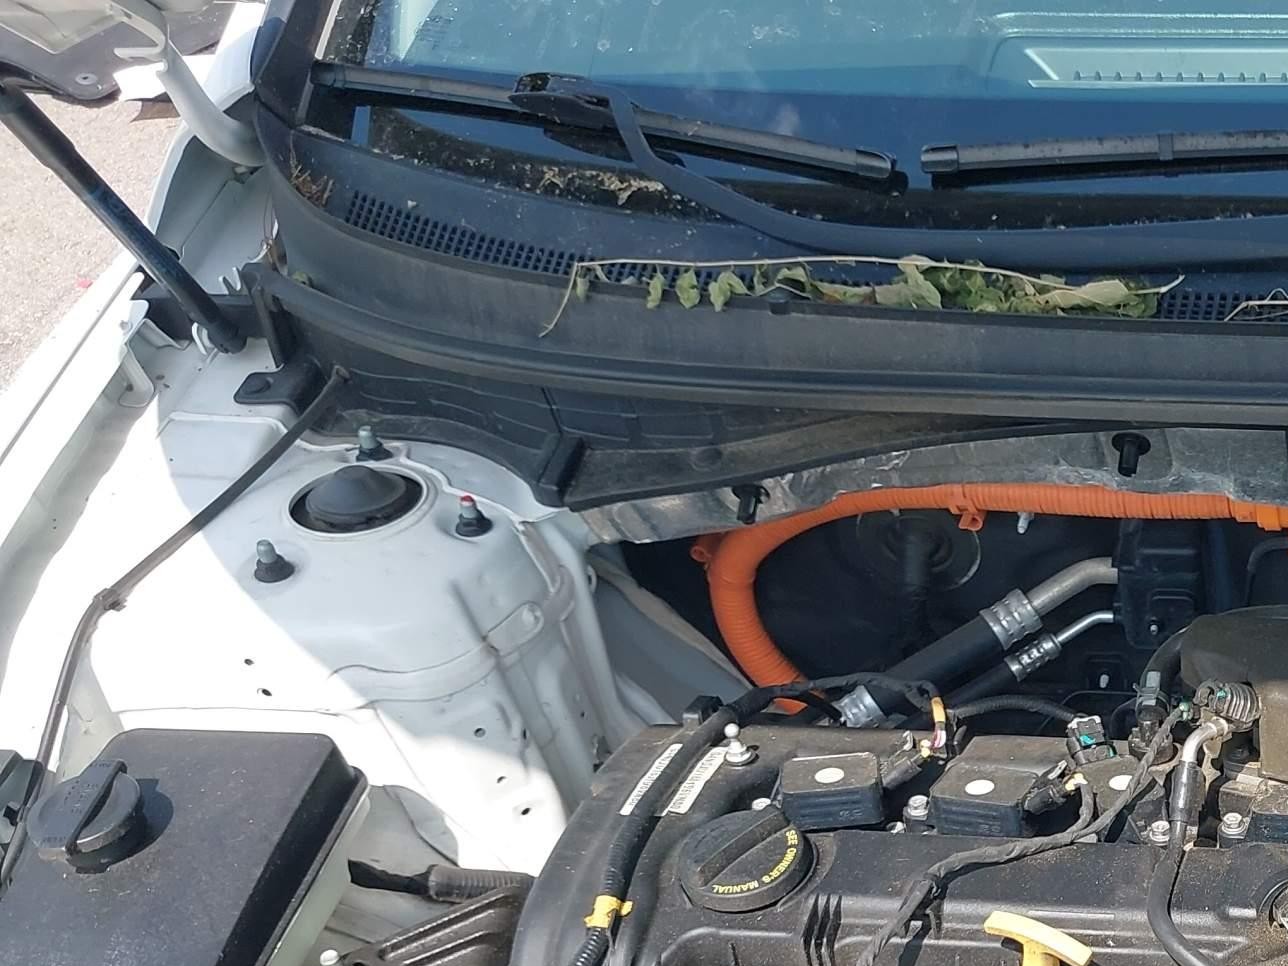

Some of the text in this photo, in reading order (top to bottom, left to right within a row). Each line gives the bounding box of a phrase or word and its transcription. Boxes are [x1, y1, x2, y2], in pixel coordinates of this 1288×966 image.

[711, 829, 798, 893] SEE OWNER'S MANUAL
